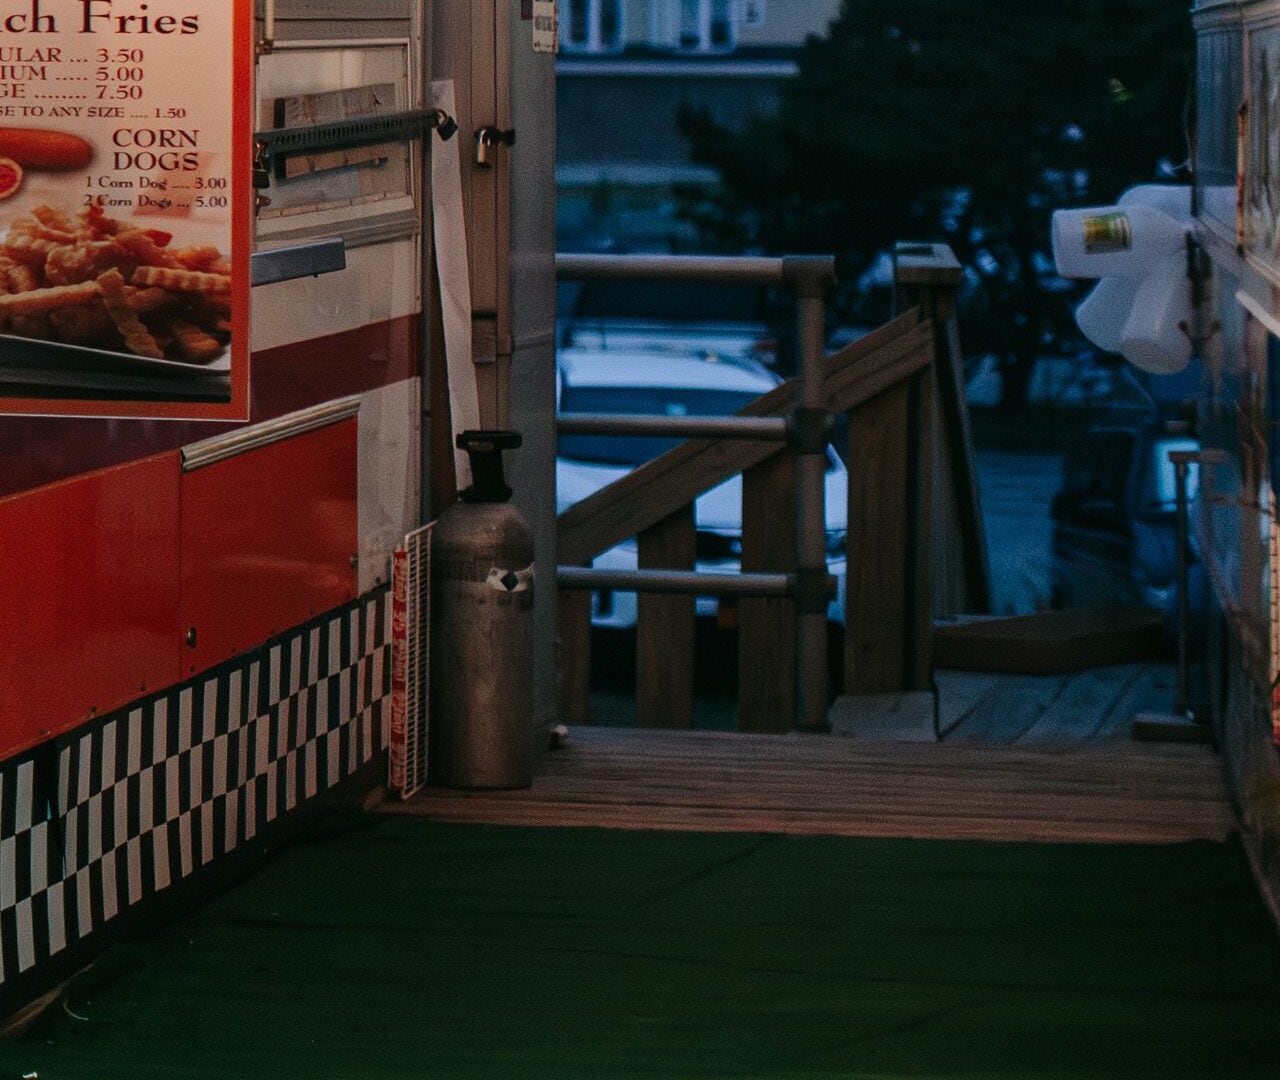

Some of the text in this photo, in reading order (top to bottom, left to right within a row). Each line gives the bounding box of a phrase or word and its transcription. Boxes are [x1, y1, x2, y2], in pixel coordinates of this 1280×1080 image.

[95, 47, 144, 64] 3.50
[95, 66, 144, 82] 5.00
[95, 84, 144, 100] 7.50
[18, 104, 43, 118] TO
[48, 104, 83, 118] ANY
[87, 105, 125, 118] SIZE
[154, 107, 186, 119] 1.50
[112, 128, 200, 148] CORN
[112, 151, 200, 171] DOGS
[85, 176, 227, 191] 1 Corn Dog 3.00
[83, 195, 93, 207] 2
[98, 195, 133, 208] Corn
[195, 195, 228, 208] 5.00
